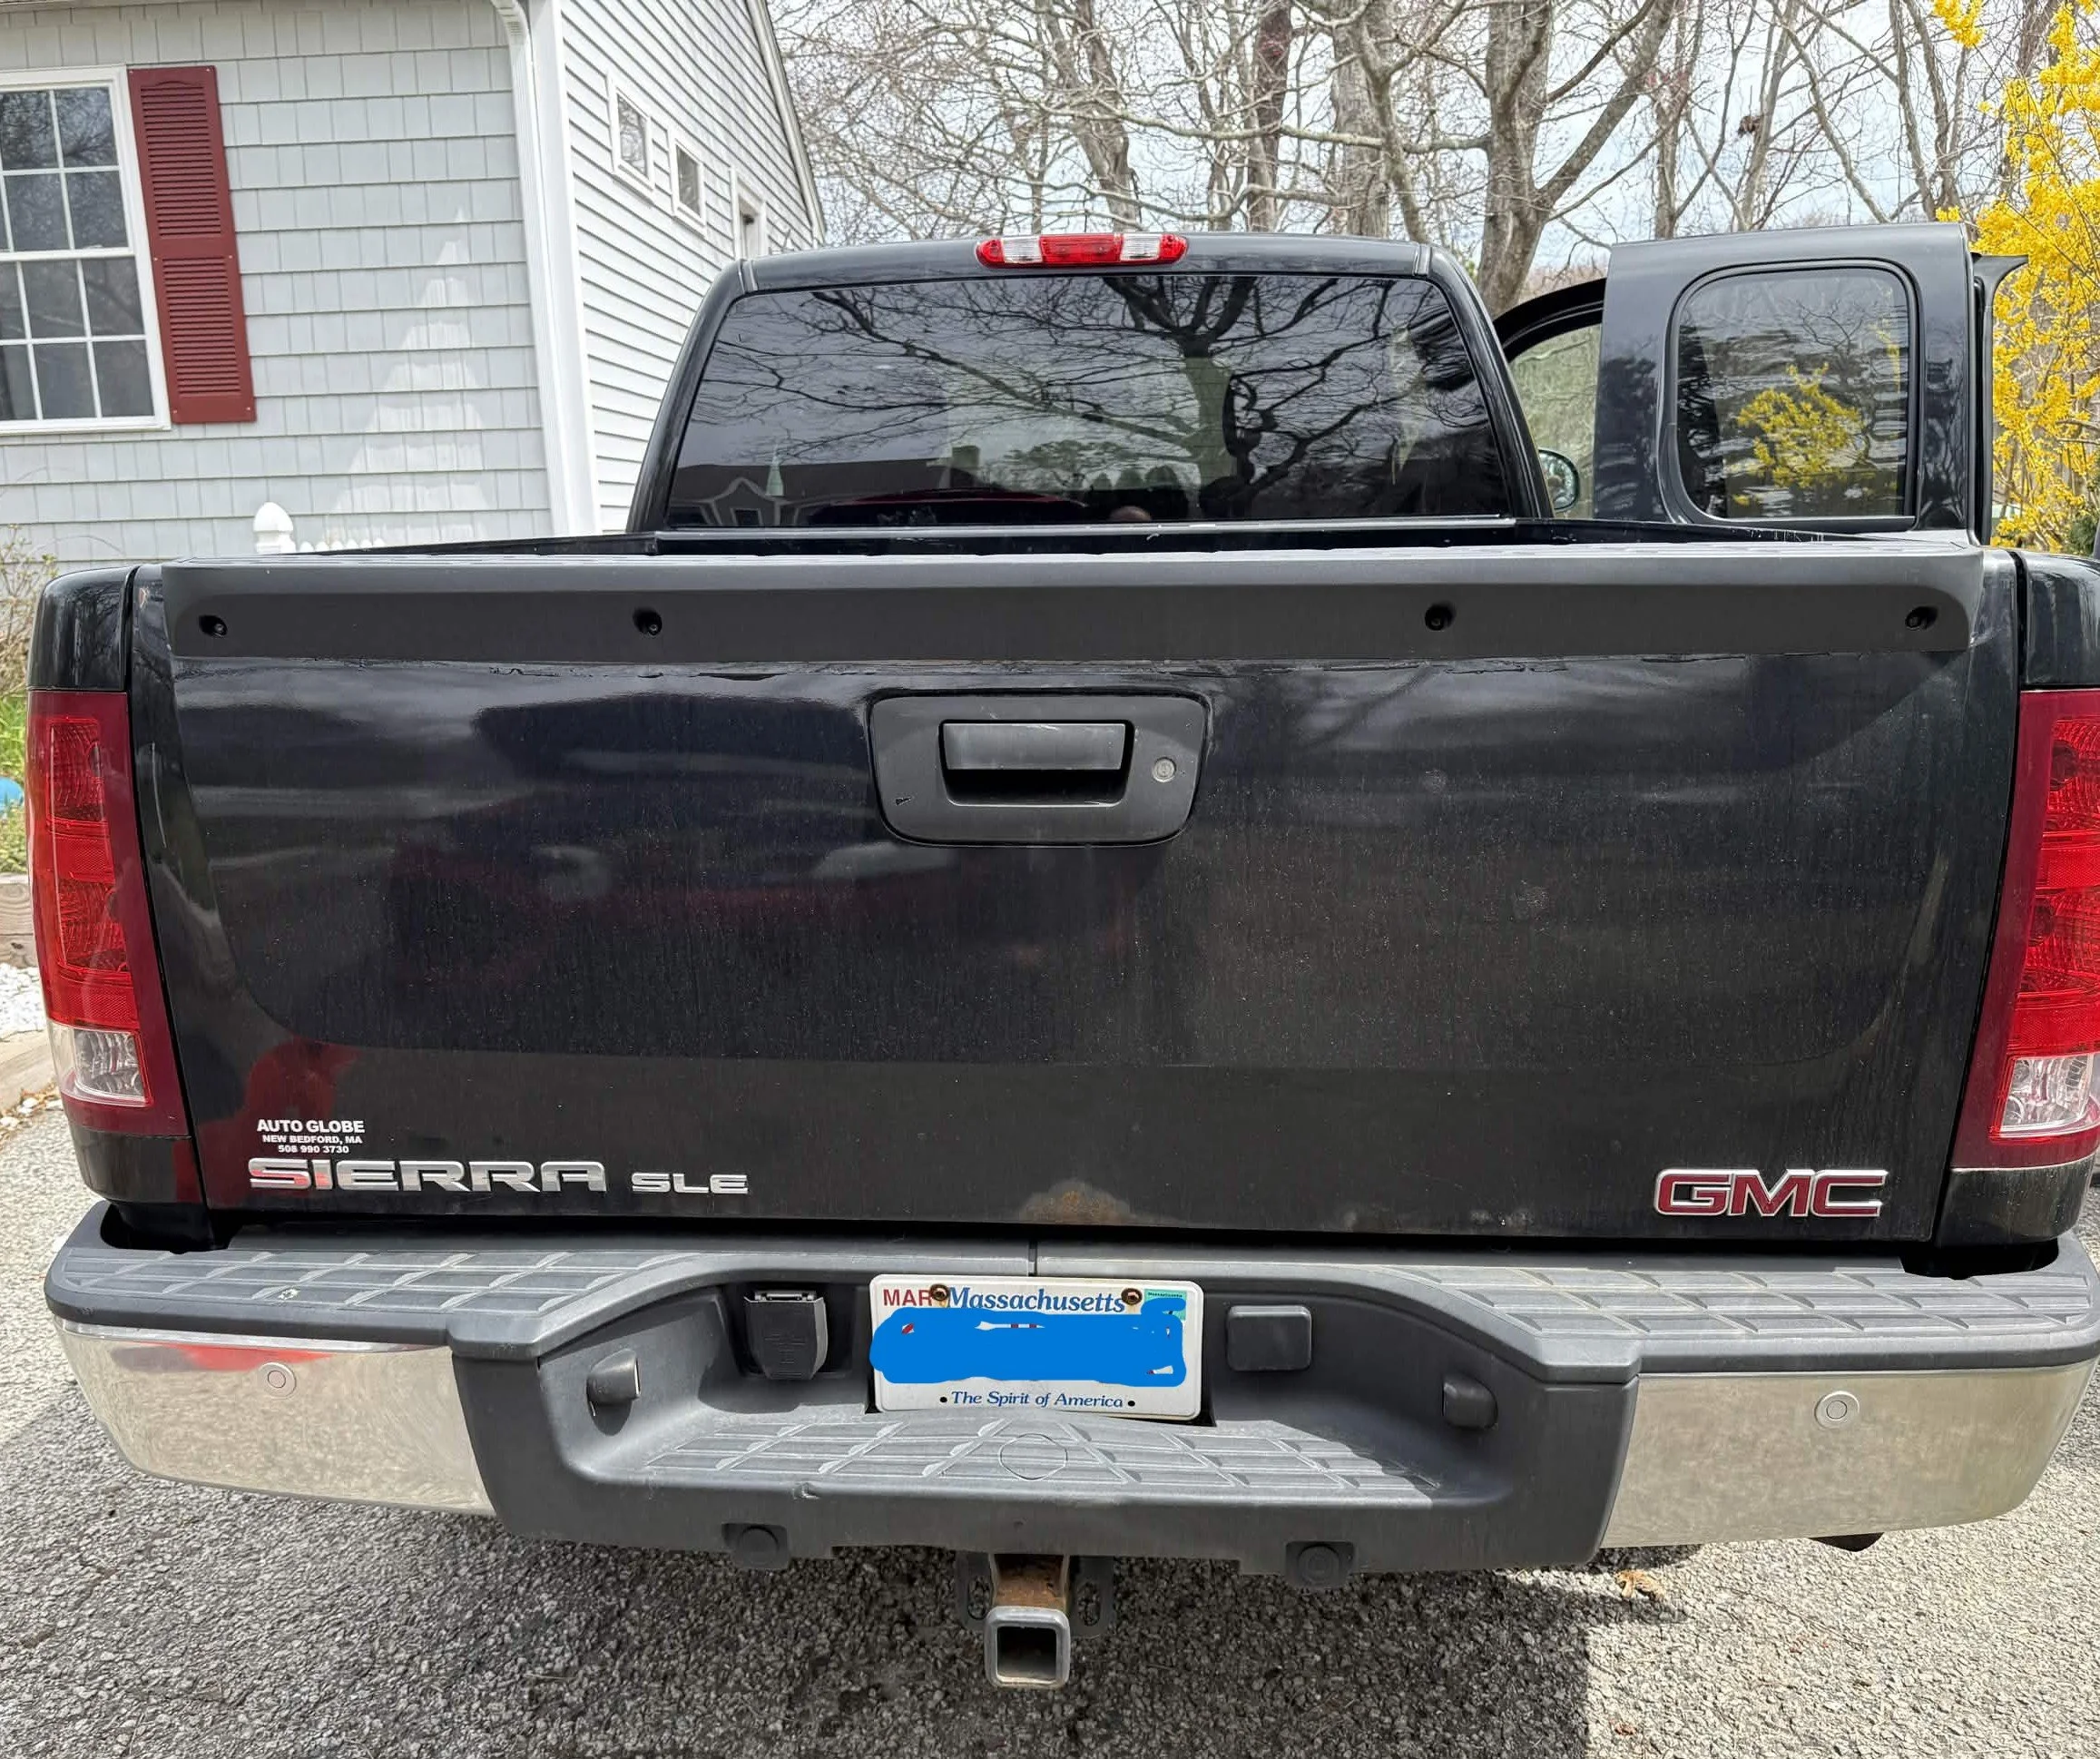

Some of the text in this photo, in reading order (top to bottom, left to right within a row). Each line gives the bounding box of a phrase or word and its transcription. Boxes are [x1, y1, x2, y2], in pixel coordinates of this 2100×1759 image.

[257, 1119, 365, 1133] AUTO GLOBE
[262, 1135, 287, 1144] NEW
[289, 1135, 343, 1145] BEDFORD,
[278, 1145, 349, 1154] 508 990 3730
[248, 1157, 748, 1194] SIERRA SLE
[1654, 1169, 1887, 1217] GMC
[883, 1289, 933, 1307] MAR
[947, 1287, 1125, 1312] Massachusetts
[951, 1390, 1123, 1408] The Spirit of America
